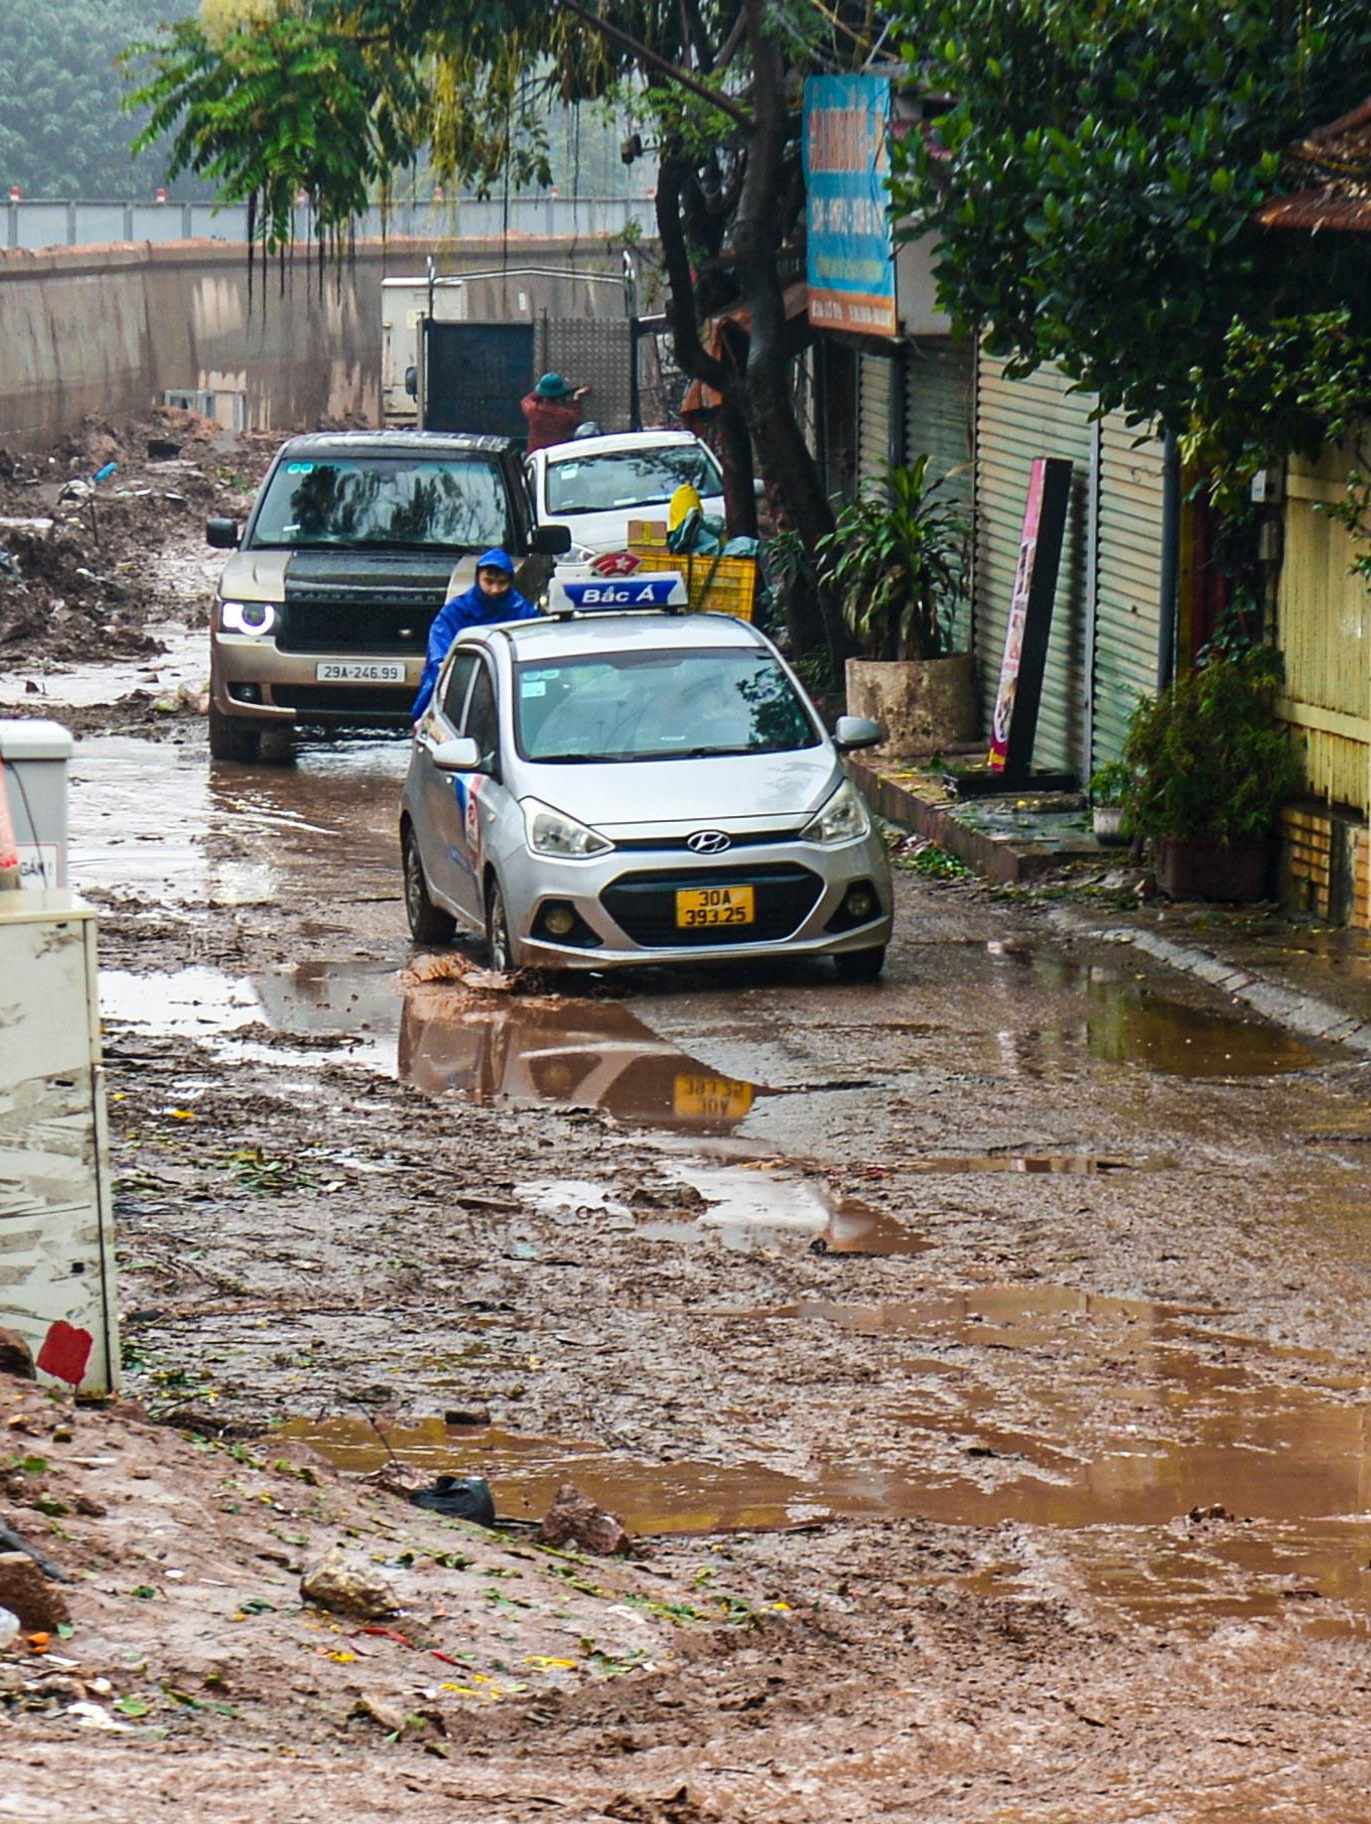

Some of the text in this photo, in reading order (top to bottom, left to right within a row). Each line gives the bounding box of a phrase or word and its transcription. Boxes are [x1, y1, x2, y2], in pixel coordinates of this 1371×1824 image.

[636, 584, 655, 602] Á
[324, 665, 399, 680] 29A-246.99
[699, 889, 731, 907] 30A
[685, 905, 747, 926] 393.25
